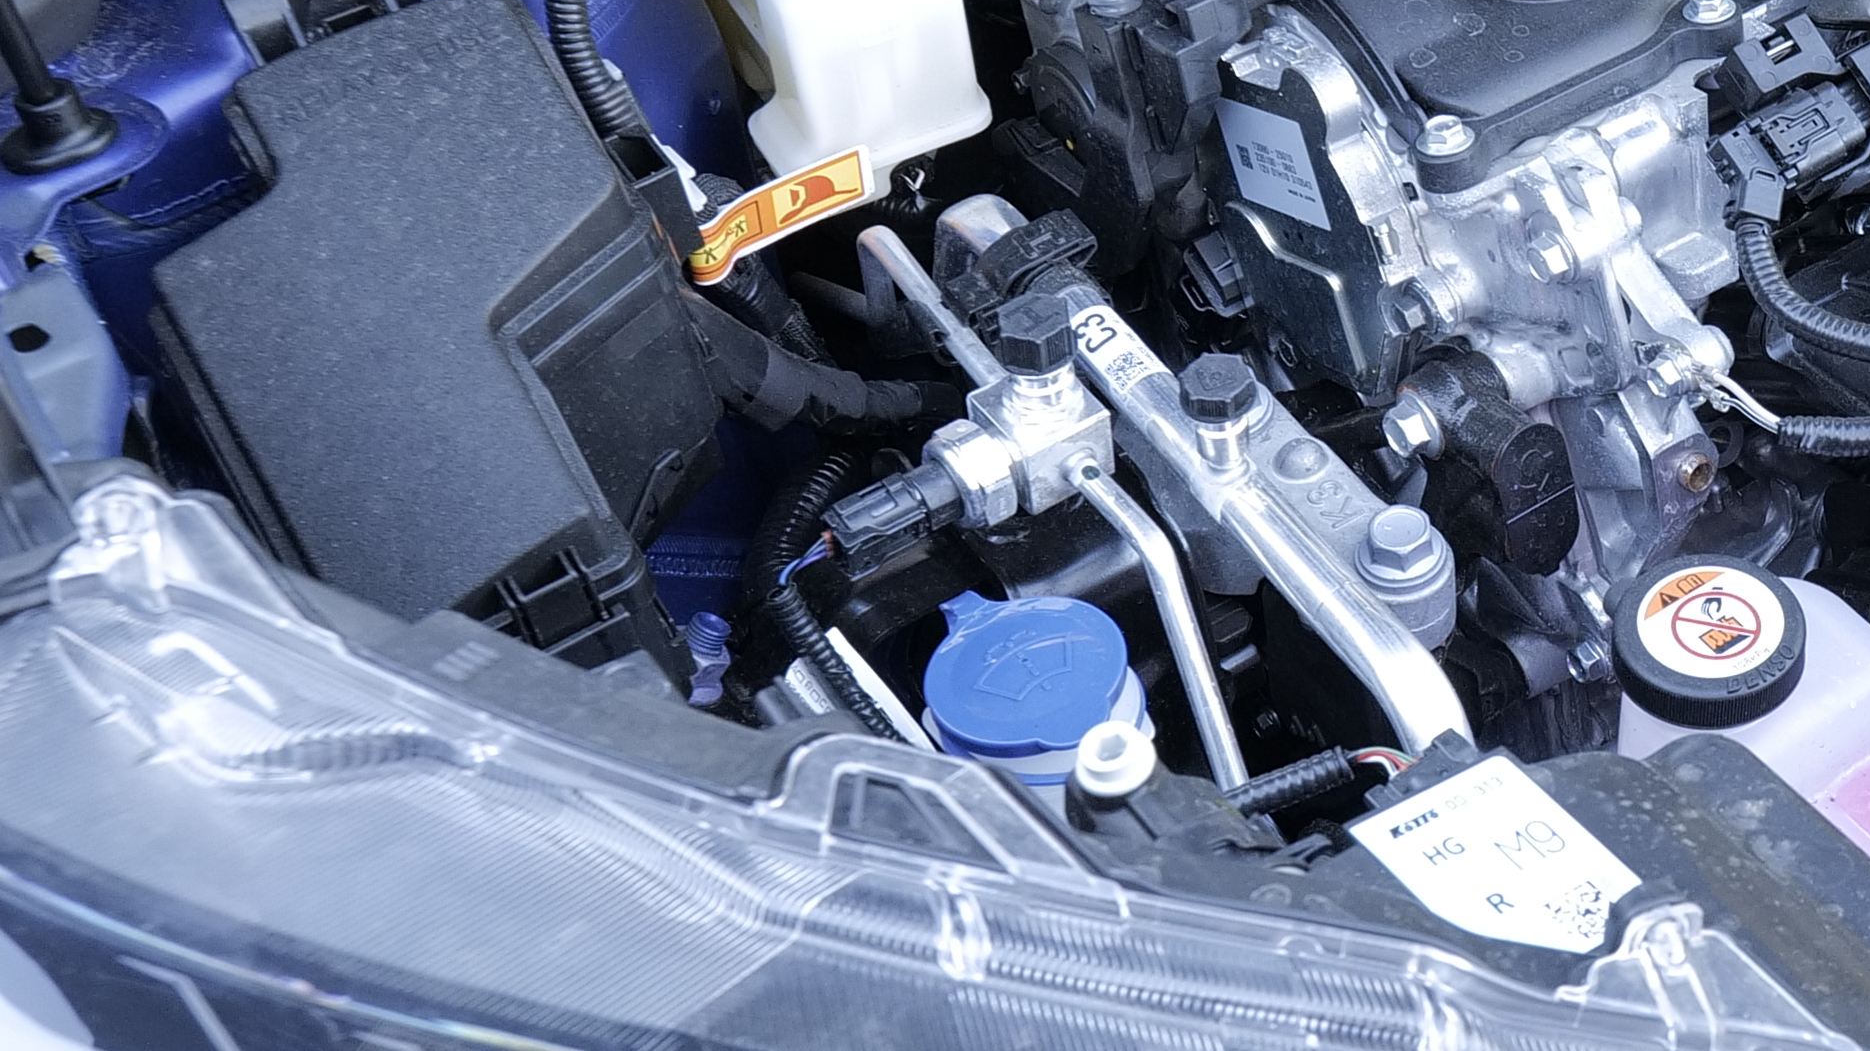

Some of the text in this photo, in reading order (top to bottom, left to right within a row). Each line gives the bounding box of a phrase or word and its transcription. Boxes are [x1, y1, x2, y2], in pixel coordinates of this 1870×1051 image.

[1074, 313, 1118, 354] C3
[1306, 479, 1366, 530] K3
[1726, 644, 1796, 695] DENSO
[1422, 820, 1566, 871] HG M9
[1485, 892, 1515, 914] R
